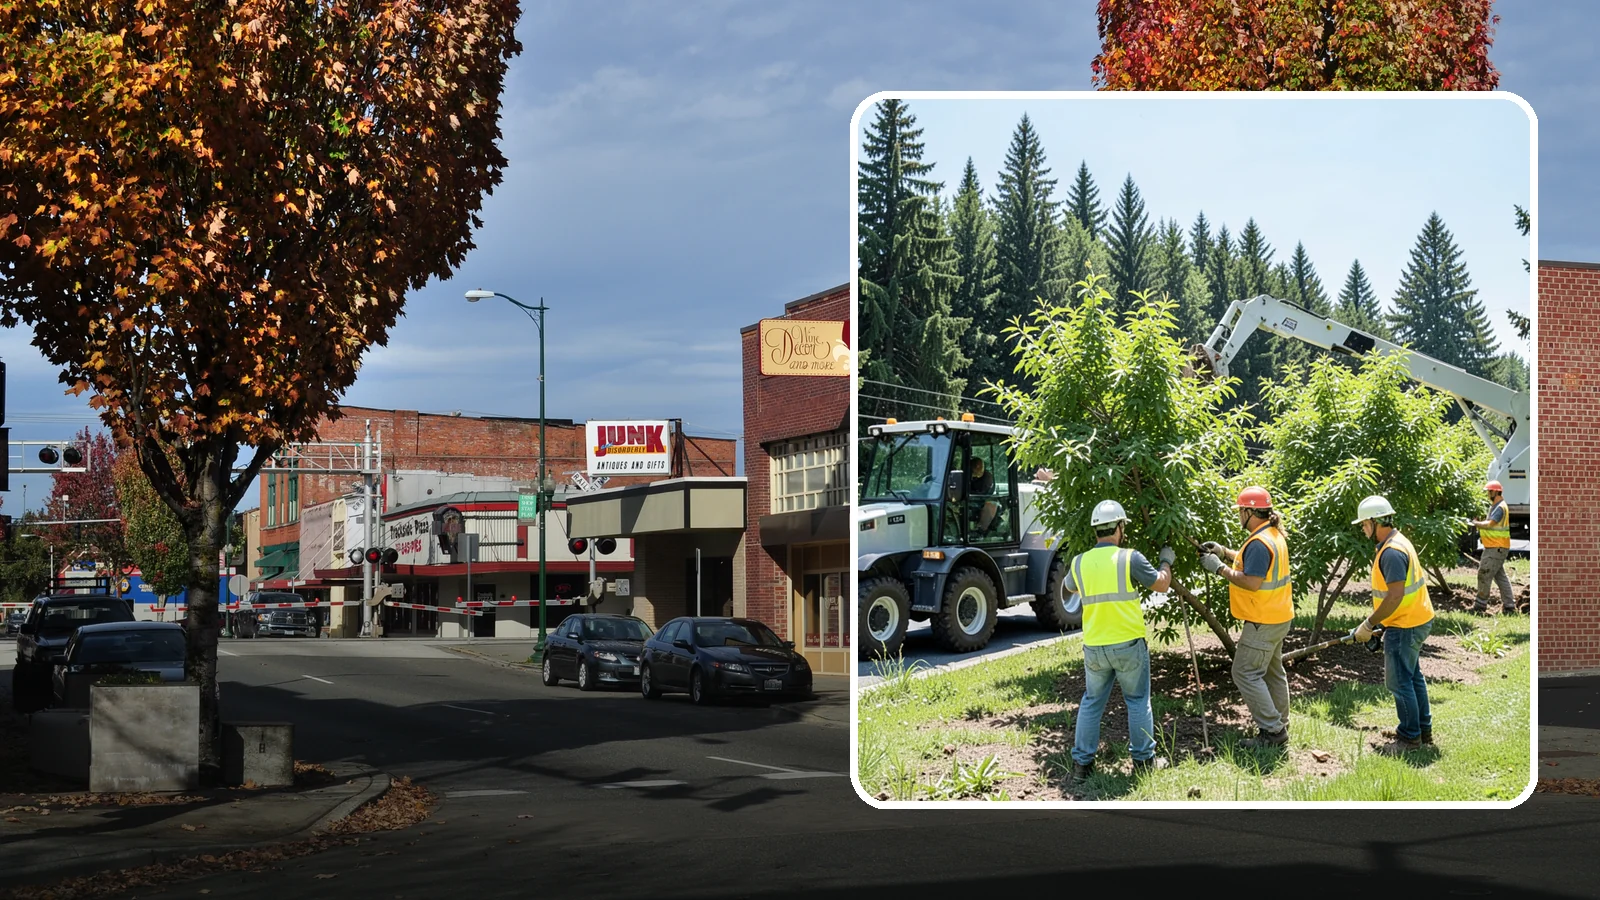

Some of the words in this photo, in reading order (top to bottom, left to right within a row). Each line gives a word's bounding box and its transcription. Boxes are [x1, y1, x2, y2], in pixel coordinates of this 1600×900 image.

[595, 425, 665, 457] JUNK
[607, 446, 646, 454] DISORDERLY
[597, 461, 628, 470] ANTIQUES
[631, 461, 644, 470] AND
[647, 460, 665, 470] GIFTS
[414, 519, 429, 535] Pizza
